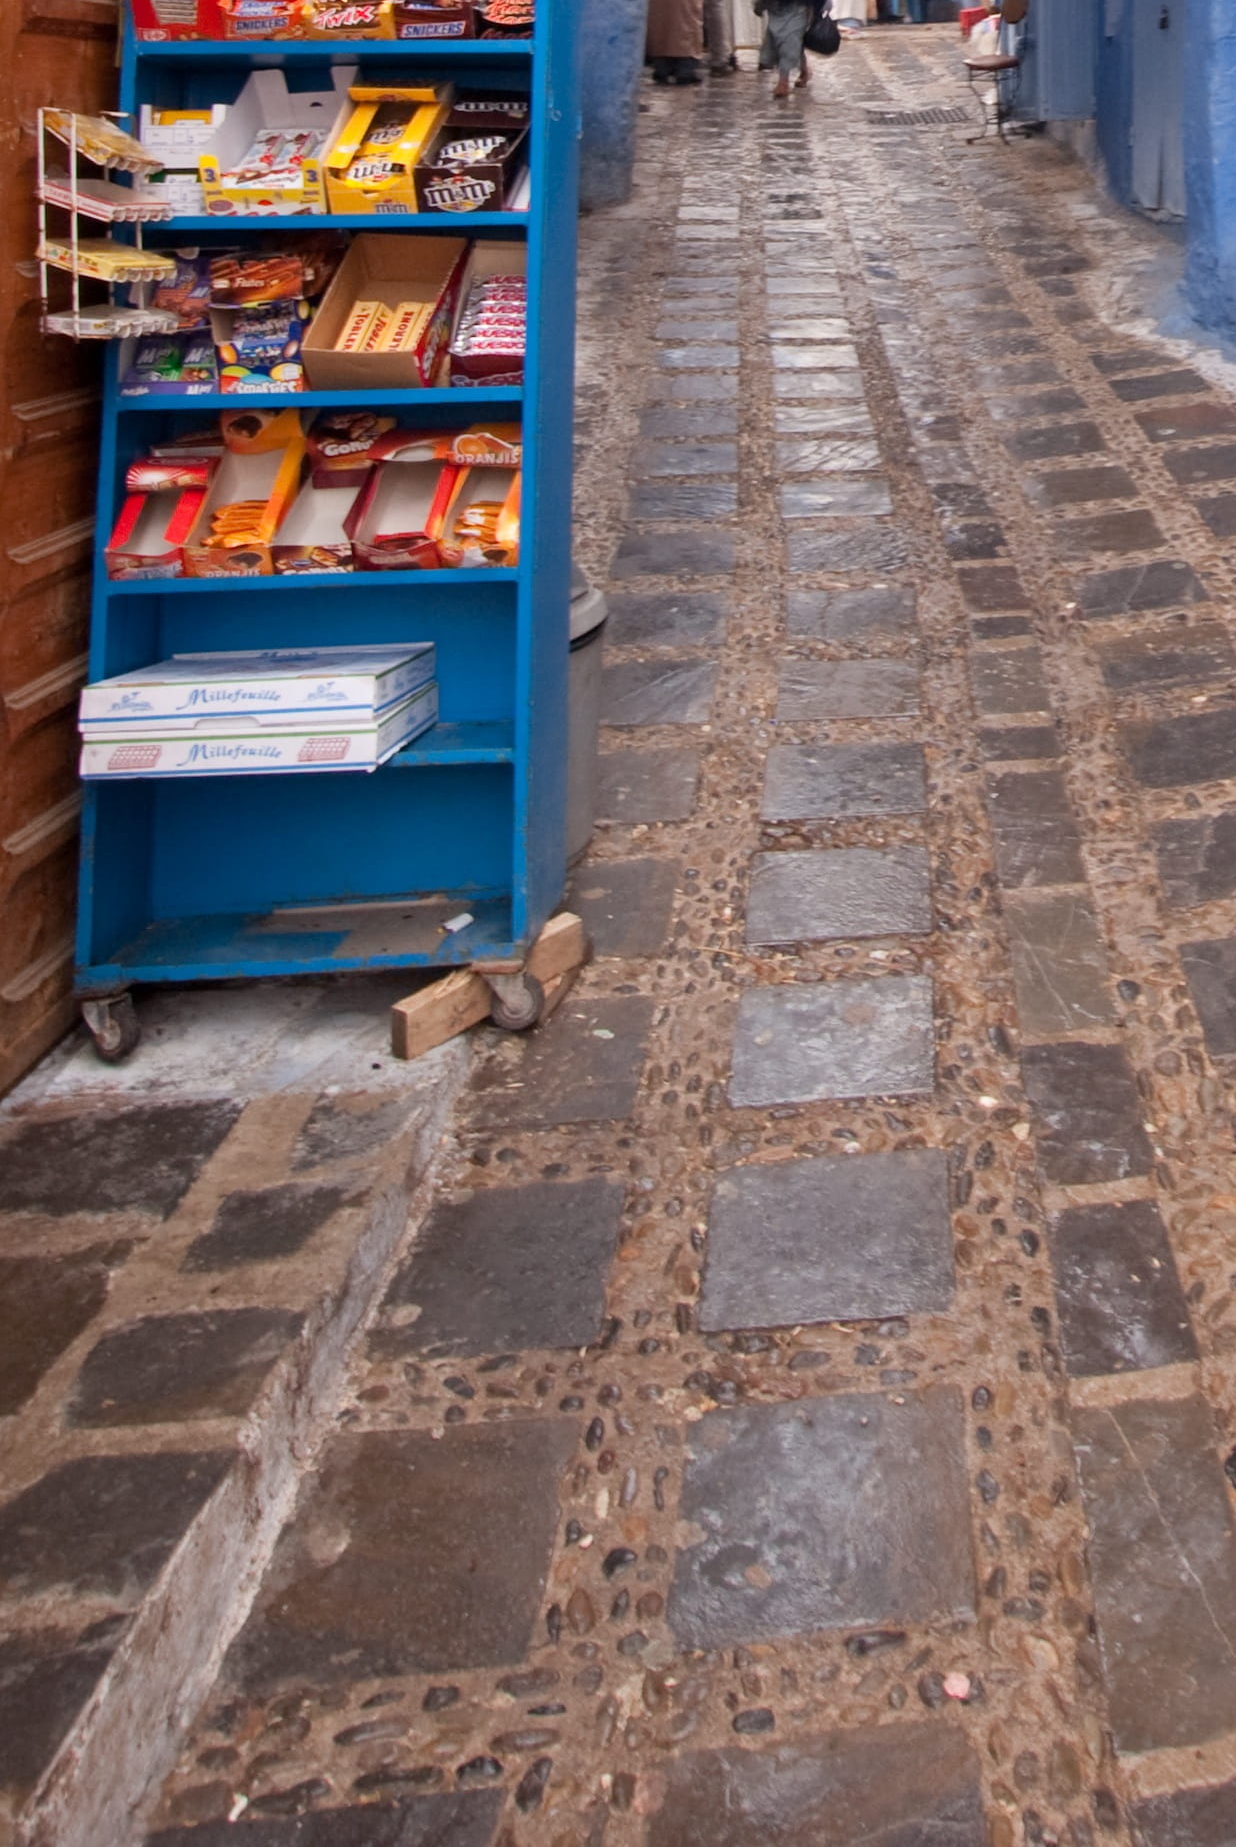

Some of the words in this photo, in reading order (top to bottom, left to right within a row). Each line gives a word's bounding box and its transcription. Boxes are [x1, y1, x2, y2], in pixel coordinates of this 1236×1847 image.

[235, 17, 288, 32] SNICKERS
[404, 23, 464, 37] SNICKERS
[203, 167, 217, 183] 3
[307, 168, 320, 183] 3
[425, 180, 496, 207] m&m's
[176, 688, 281, 711] Millefeuille
[176, 743, 283, 766] Millefeuille
